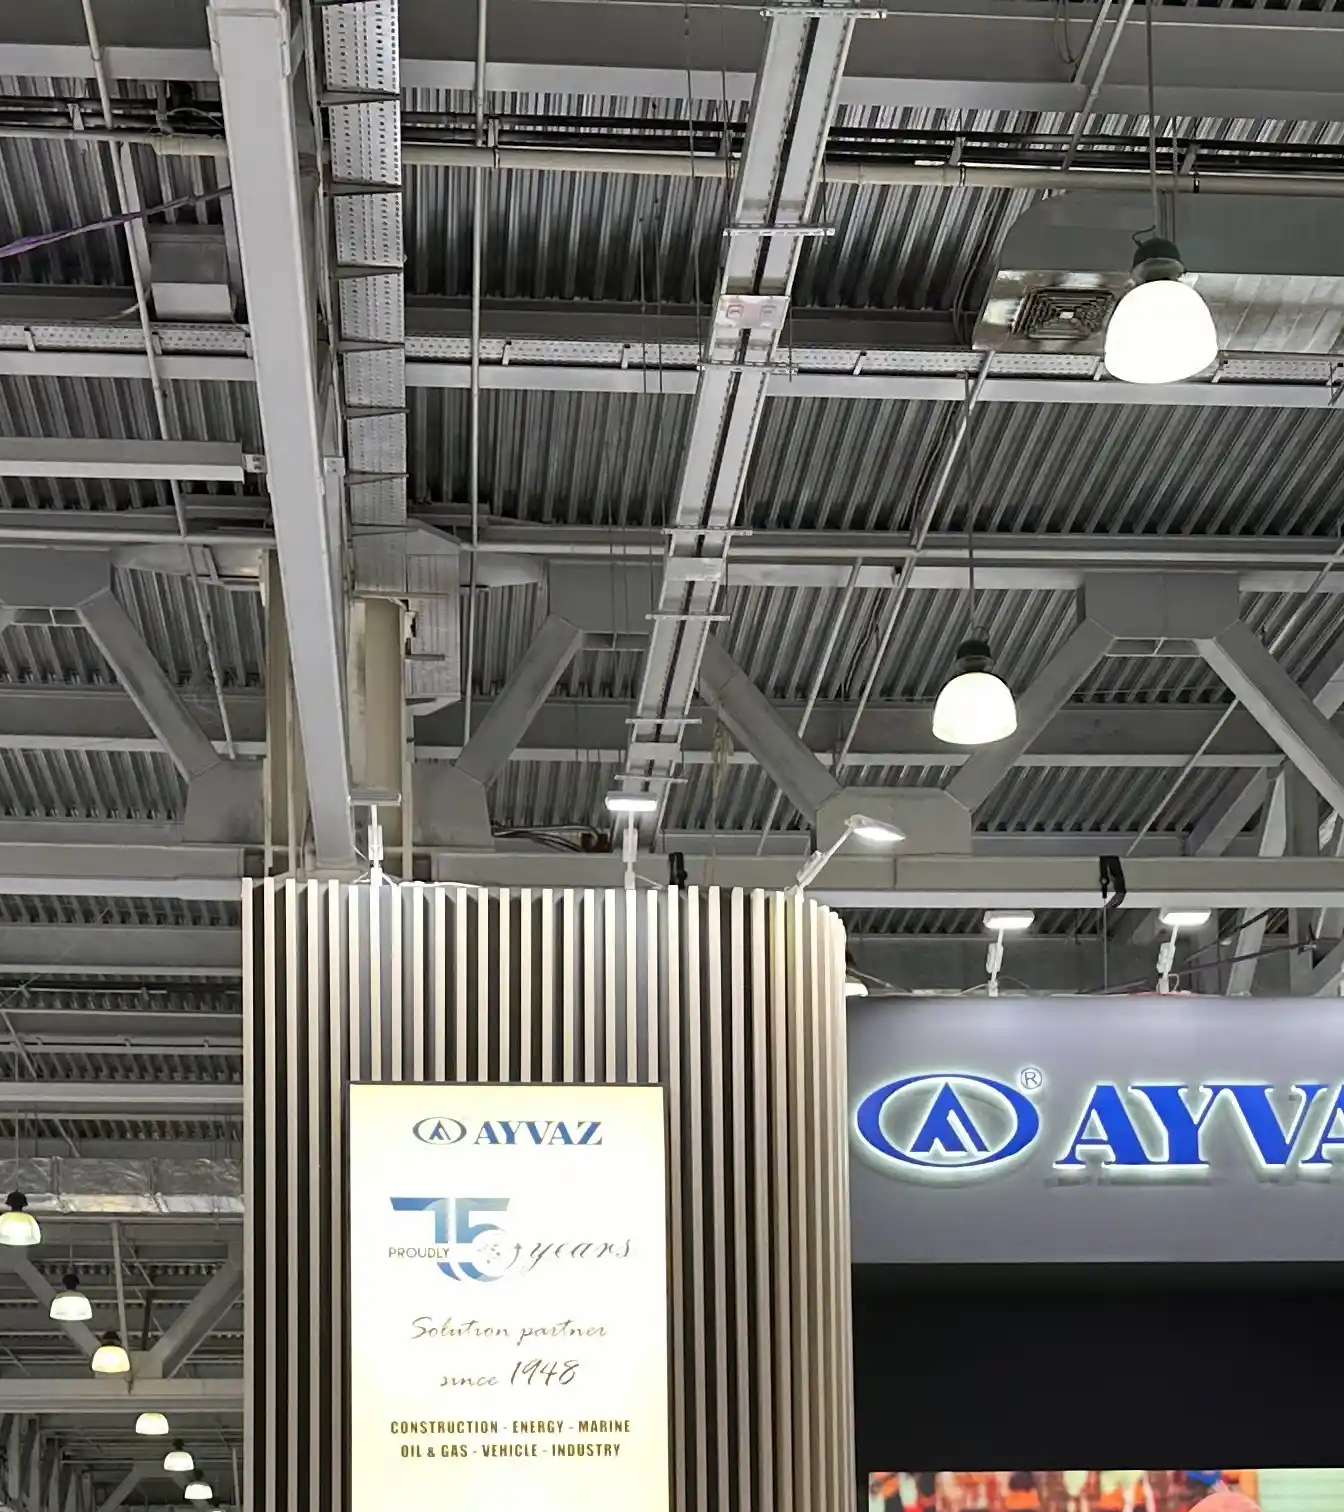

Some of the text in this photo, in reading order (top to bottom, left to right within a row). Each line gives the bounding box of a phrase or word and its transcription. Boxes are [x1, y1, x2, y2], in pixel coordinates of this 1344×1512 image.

[474, 1120, 603, 1146] AYVAZ
[388, 1238, 633, 1277] PROUDLY years
[411, 1315, 608, 1347] Solution partner
[510, 1358, 581, 1386] 1948
[390, 1419, 631, 1434] CONSTRUCTION ENERGY MARINE
[400, 1443, 621, 1458] OIL & GAS VEHICLE INDUSTRY
